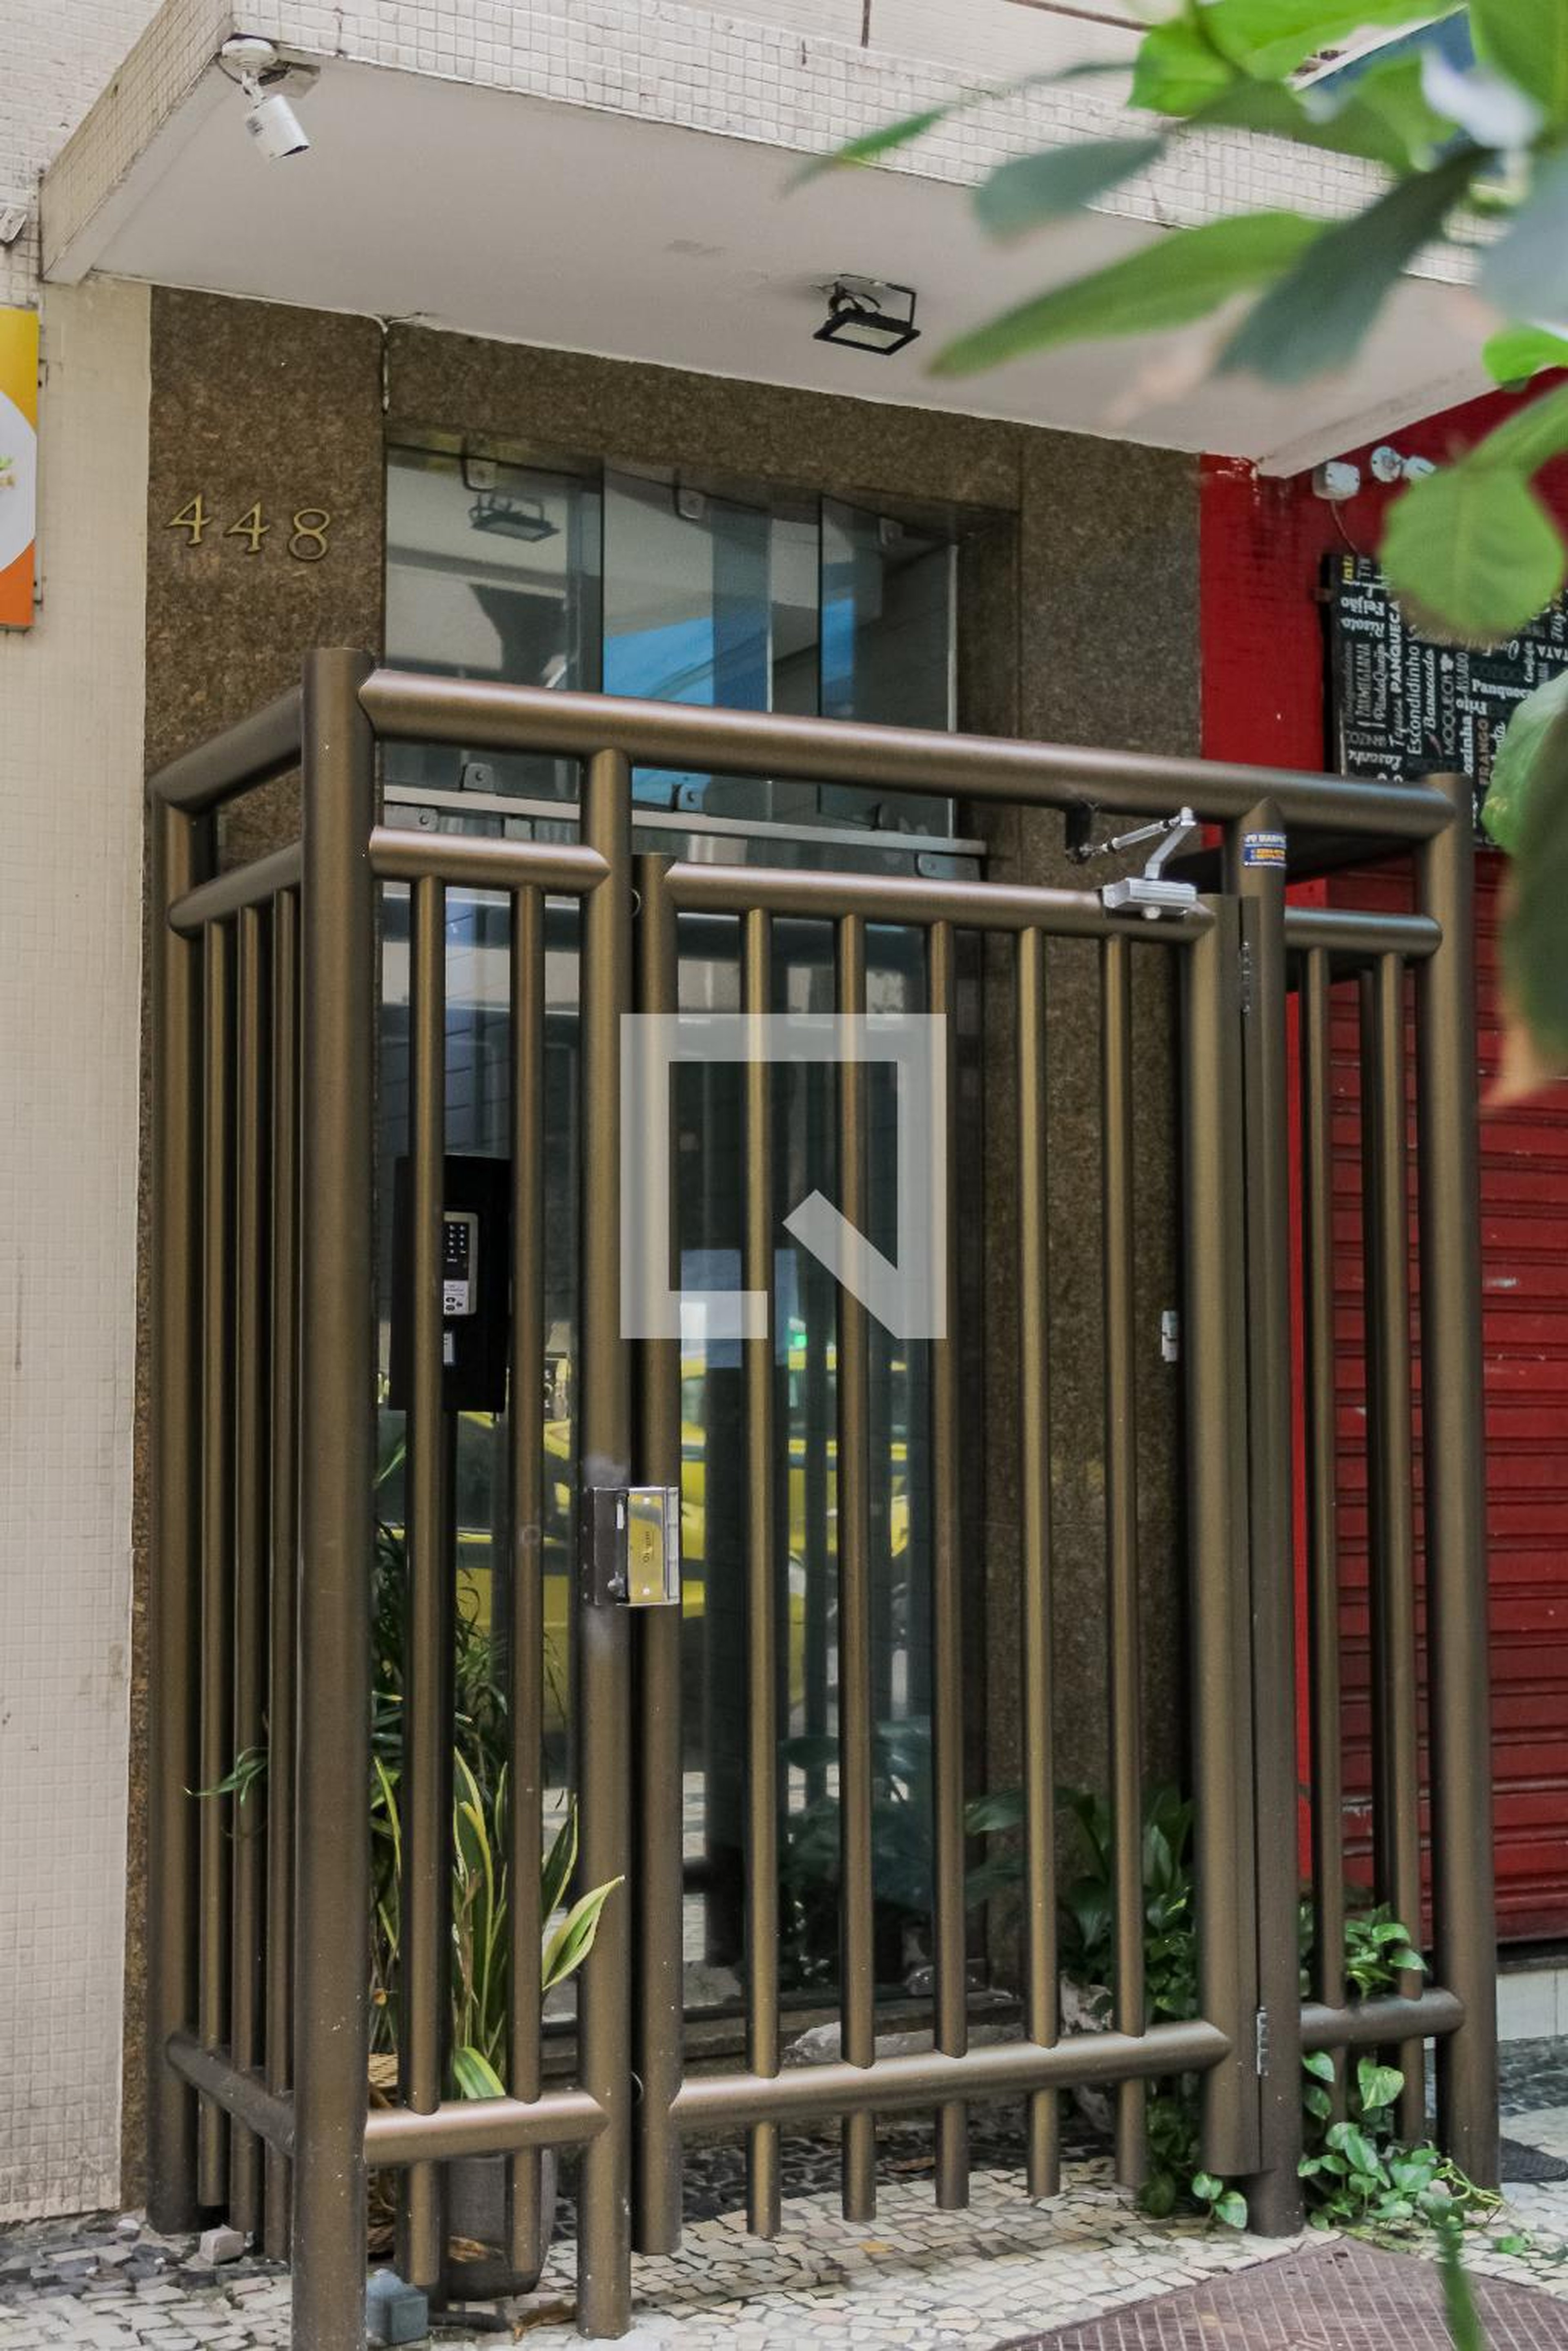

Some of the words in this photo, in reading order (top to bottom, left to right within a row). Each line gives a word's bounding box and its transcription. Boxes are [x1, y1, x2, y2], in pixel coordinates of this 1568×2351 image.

[165, 493, 331, 561] 448
[1341, 596, 1385, 616] Feijão
[1341, 618, 1385, 637] Risoto
[1389, 600, 1402, 693] PANQUECA
[1456, 652, 1469, 693] ASSADO
[1406, 646, 1421, 755] Escondidinho
[1423, 649, 1436, 729] Barreado
[1440, 676, 1455, 755] MOQUECA
[1456, 695, 1488, 715] Frito
